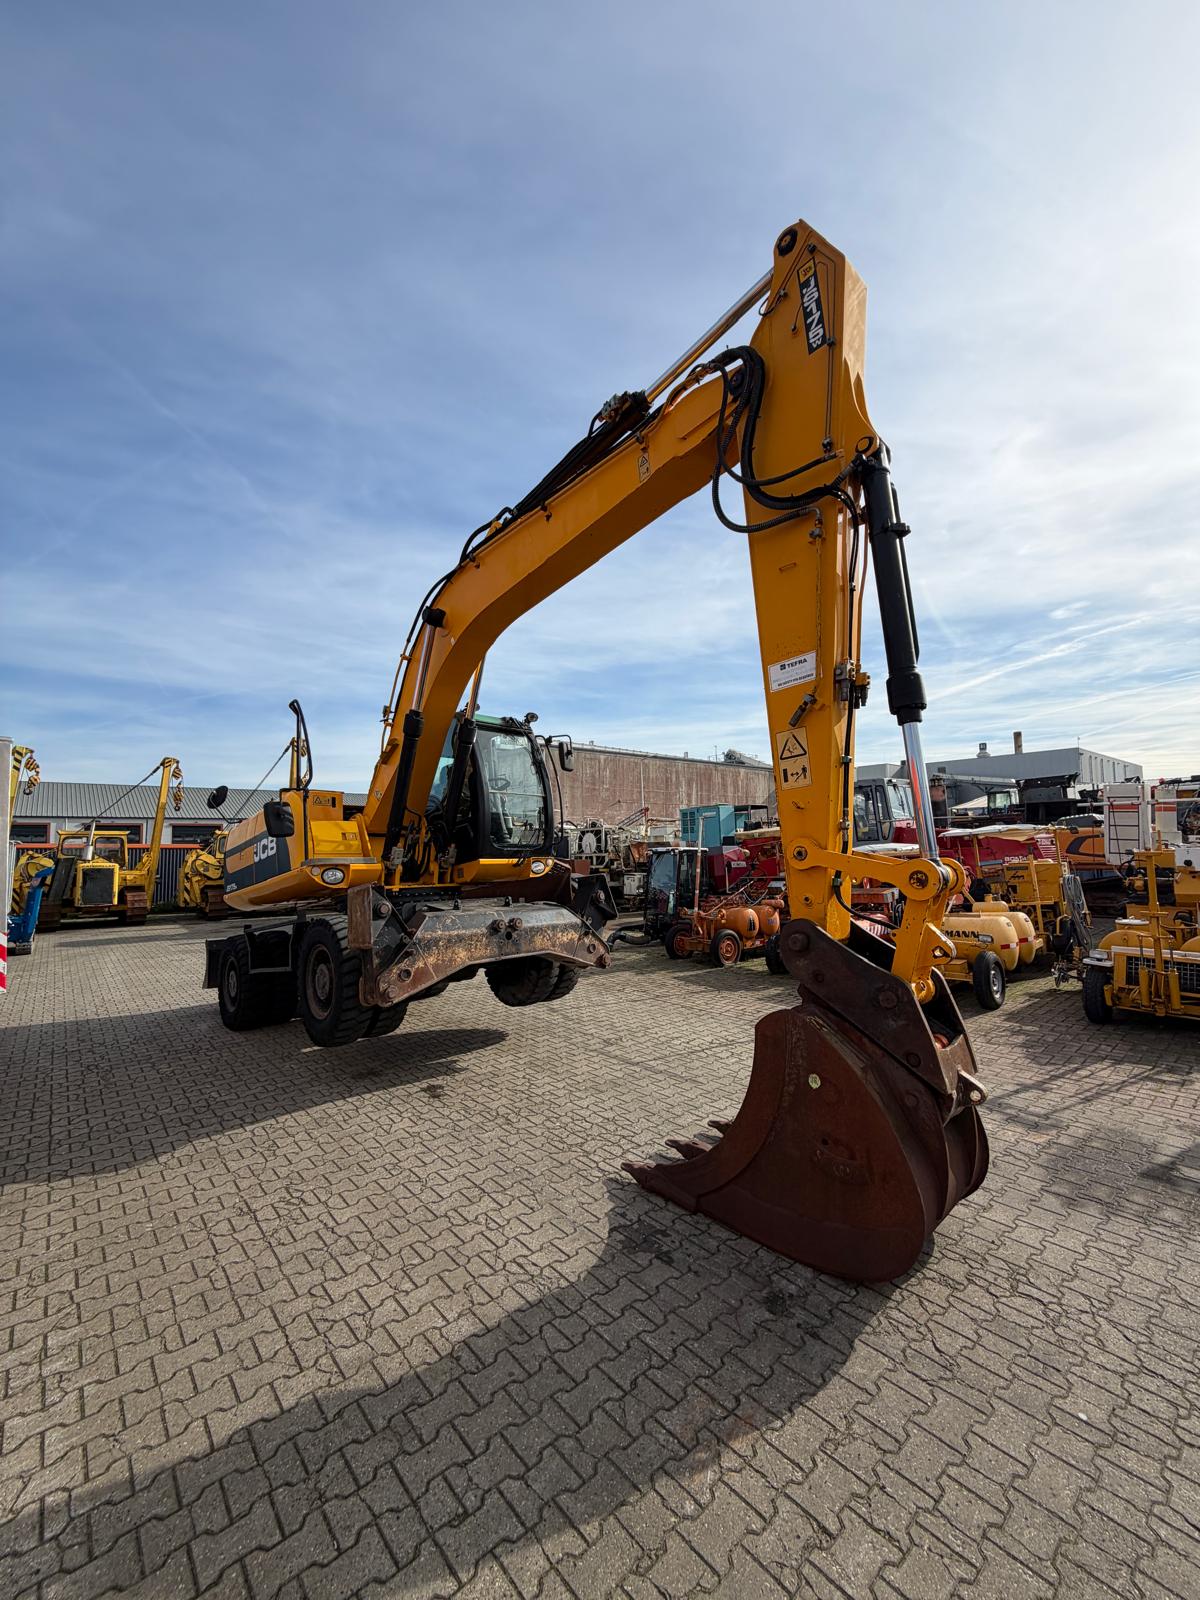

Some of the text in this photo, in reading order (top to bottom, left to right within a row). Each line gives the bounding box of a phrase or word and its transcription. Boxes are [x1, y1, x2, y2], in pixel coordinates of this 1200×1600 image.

[787, 657, 808, 669] TEFRA
[253, 836, 277, 862] JCB
[942, 930, 980, 939] MANN
